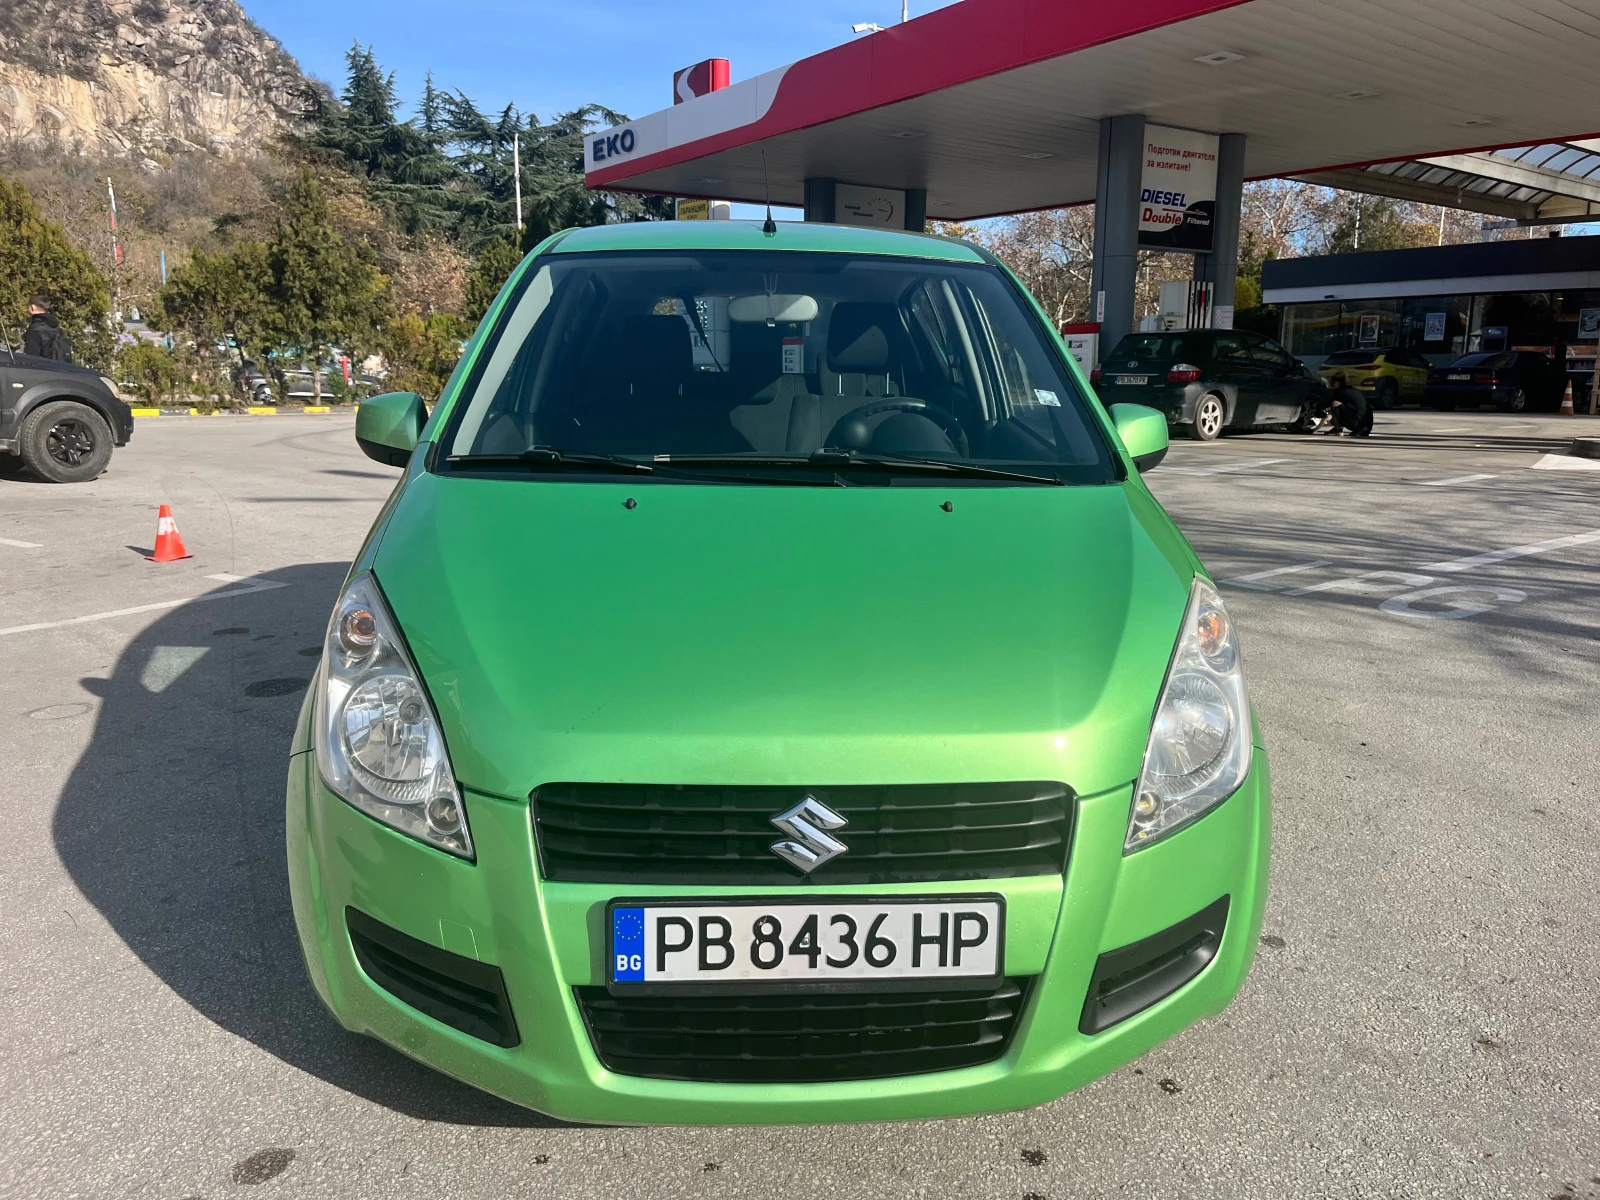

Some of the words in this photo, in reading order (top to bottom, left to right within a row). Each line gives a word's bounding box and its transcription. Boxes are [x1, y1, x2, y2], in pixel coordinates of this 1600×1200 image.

[593, 129, 634, 161] EKO
[1148, 144, 1181, 157] Подготви
[1182, 150, 1215, 161] двигателя
[1156, 160, 1191, 172] излитане!
[1140, 189, 1187, 207] DIESEL
[1142, 208, 1182, 226] Double
[1186, 217, 1210, 226] Filtered
[1217, 560, 1528, 619] LPG
[617, 954, 641, 971] BG
[655, 914, 736, 972] PB
[749, 912, 898, 969] 8436
[911, 911, 989, 968] HP
